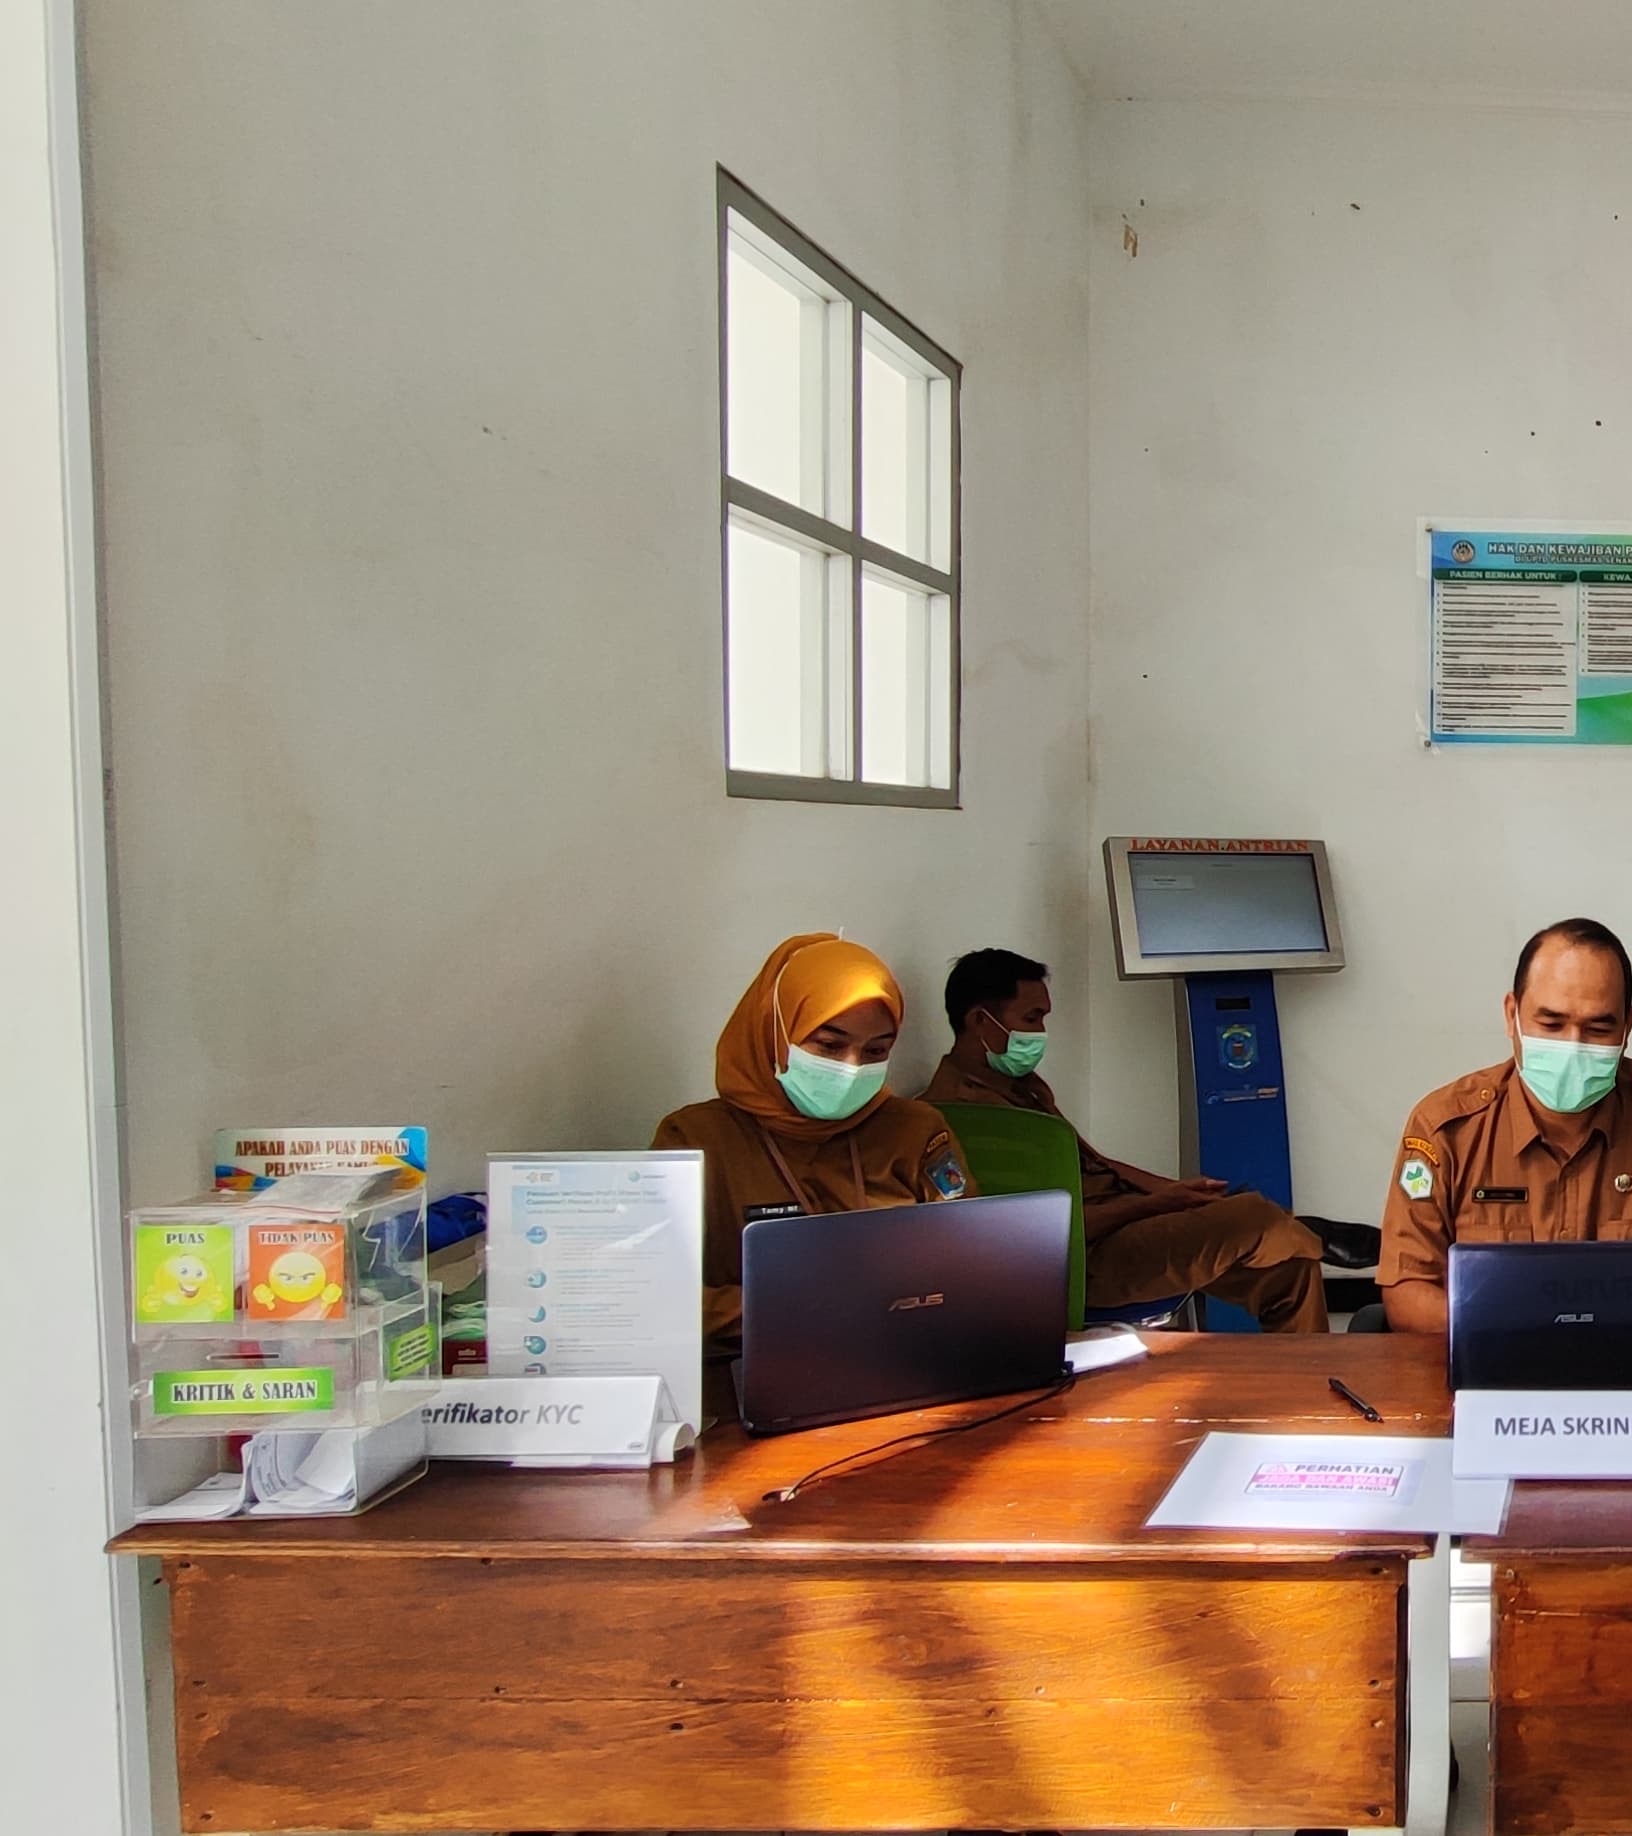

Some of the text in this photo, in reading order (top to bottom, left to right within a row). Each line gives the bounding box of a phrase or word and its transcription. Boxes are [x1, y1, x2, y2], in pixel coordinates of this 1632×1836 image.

[1488, 542, 1515, 554] HAK
[1518, 543, 1545, 555] DAN
[1548, 544, 1622, 557] KEWAJIBAN
[1449, 570, 1483, 579] PASIEN
[1524, 571, 1557, 580] UNTUK
[1131, 839, 1308, 851] LAYANAN ANTRIAN
[235, 1140, 408, 1157] APAKAH ANDA PUAS DENGAN
[166, 1233, 205, 1244] PUAS
[260, 1232, 335, 1244] TIDAK PUAS
[888, 1293, 944, 1312] ASUS
[1554, 1313, 1595, 1324] ASUS
[173, 1381, 317, 1402] KRITIK & SARAN
[421, 1402, 584, 1425] erifikator KYC
[1494, 1417, 1556, 1436] MEJA
[1294, 1464, 1394, 1475] PERHATIAN
